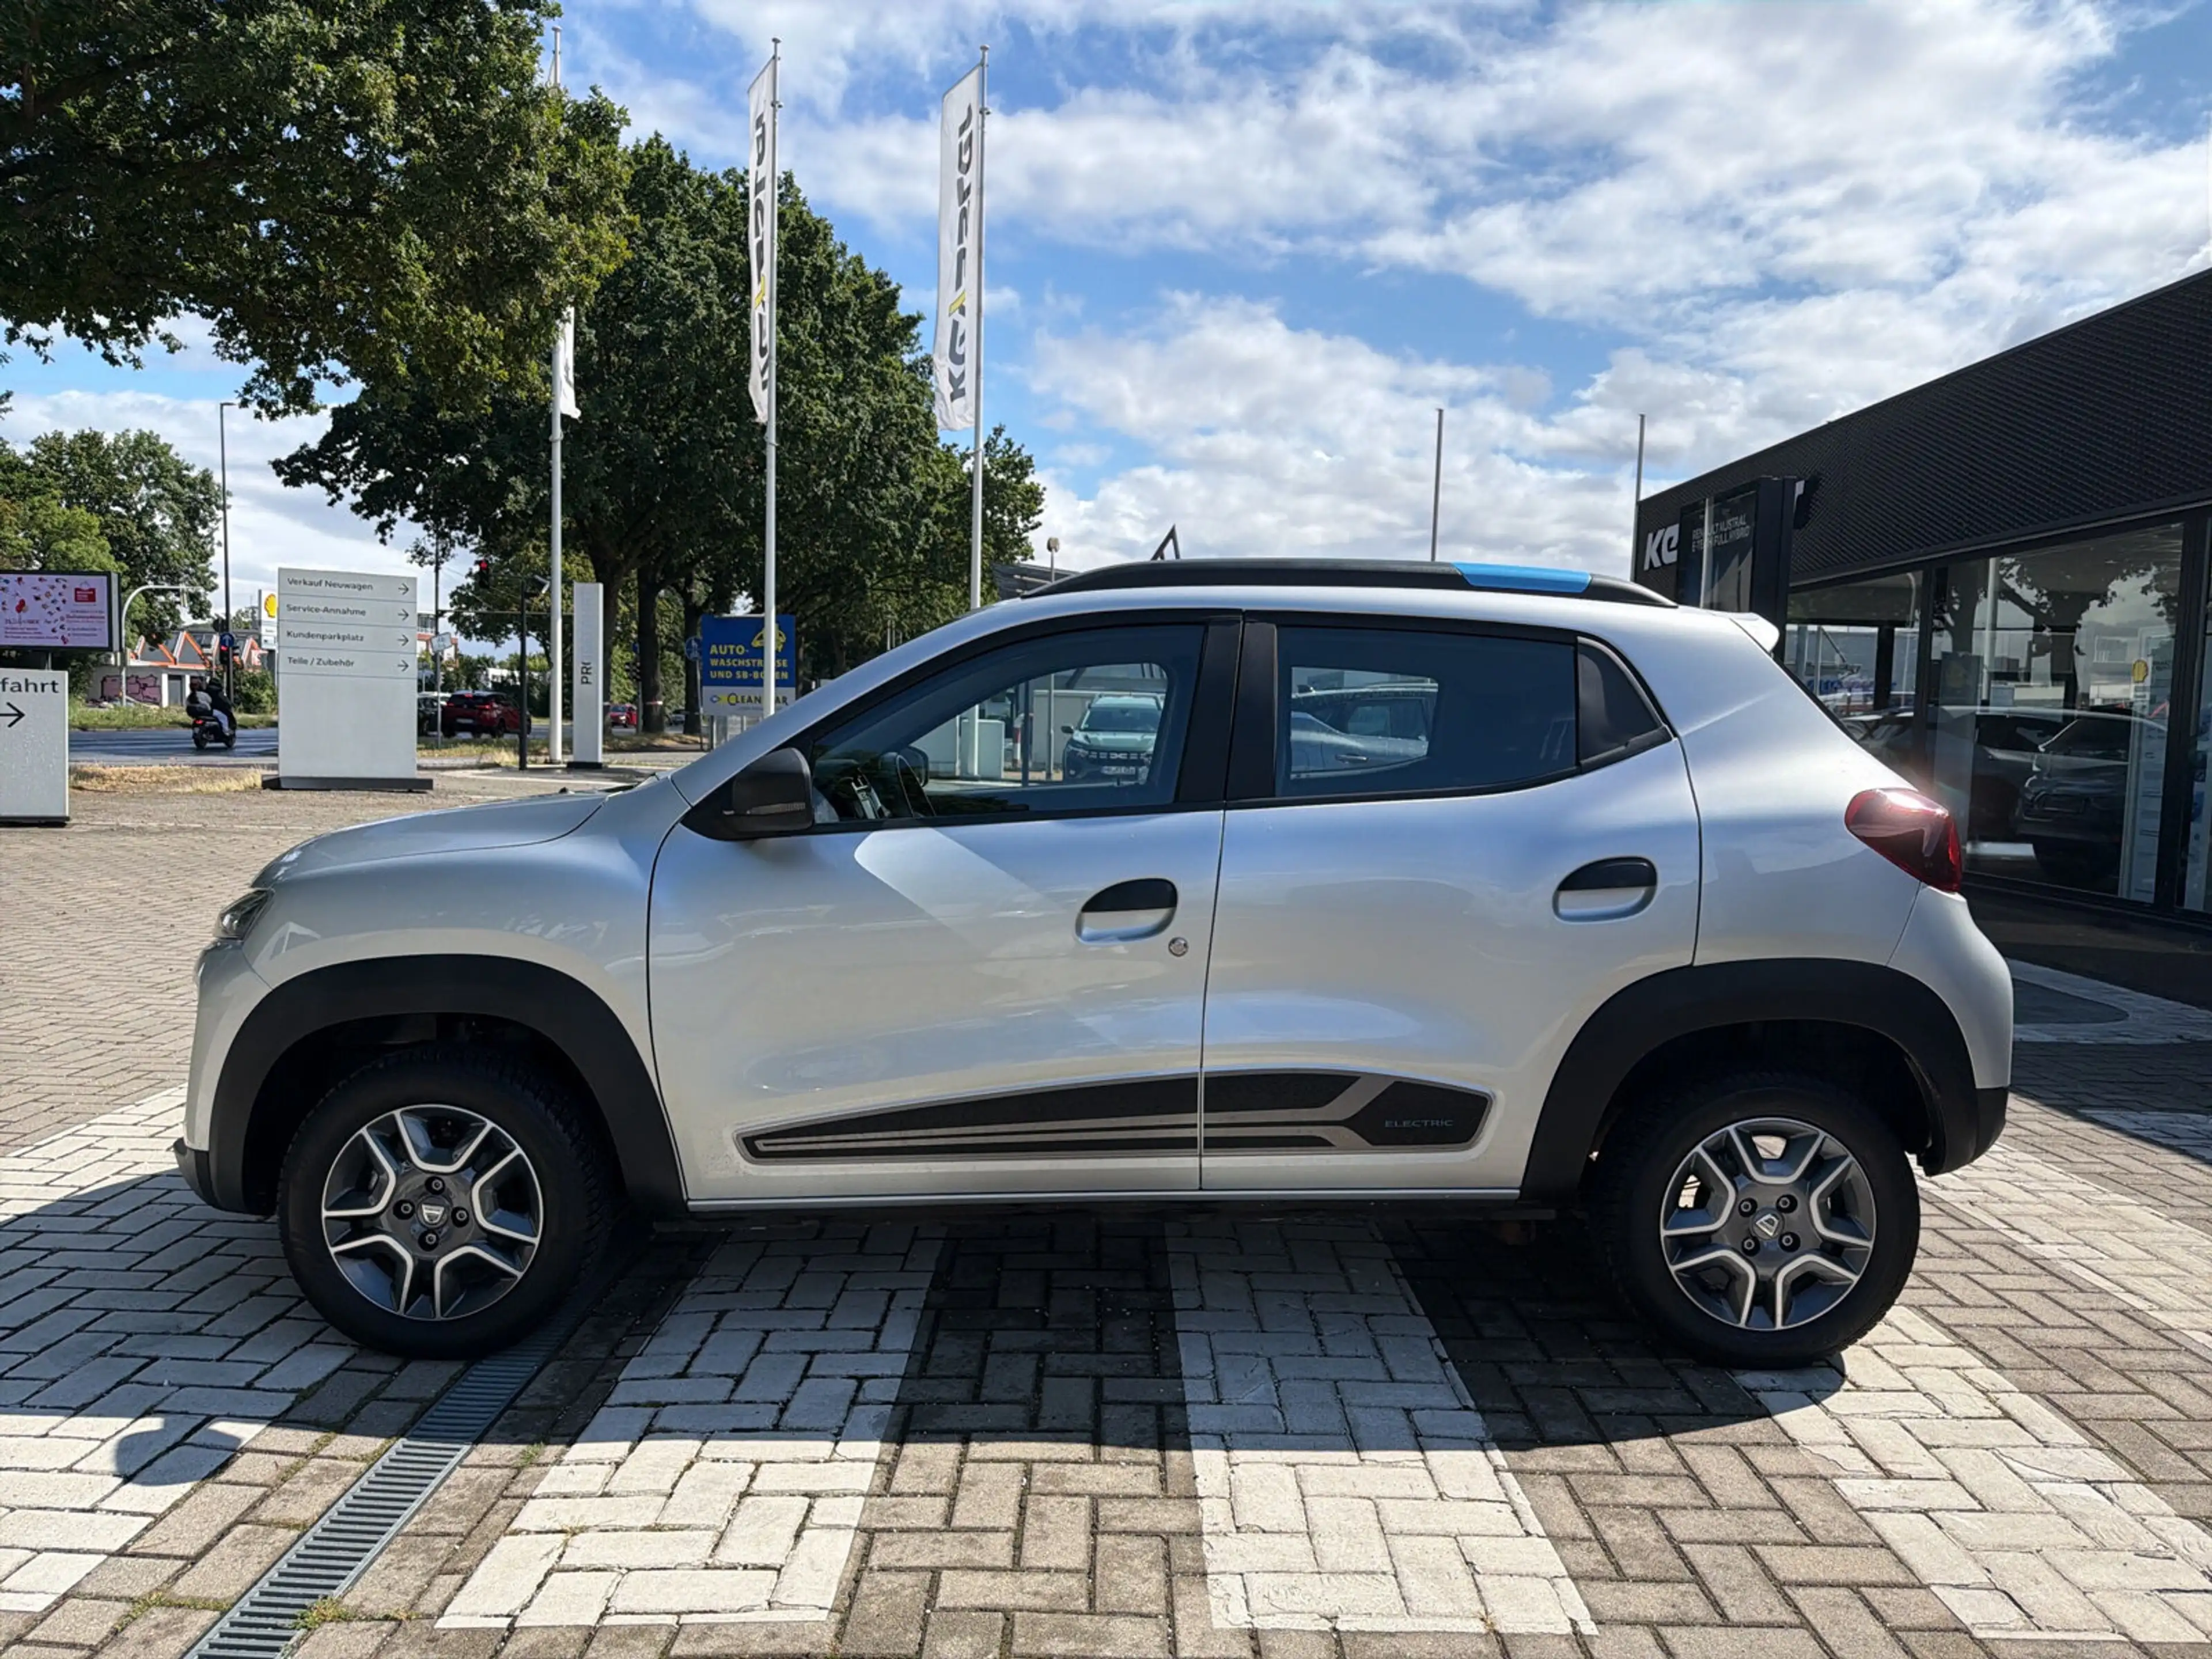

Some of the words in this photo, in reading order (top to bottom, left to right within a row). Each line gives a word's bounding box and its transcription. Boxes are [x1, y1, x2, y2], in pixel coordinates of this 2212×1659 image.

[287, 578, 323, 588] Verkauf
[325, 581, 373, 592] Neuwagen
[287, 604, 366, 616] Service-Annahme
[287, 631, 364, 642] Kundenparkplatz
[710, 644, 749, 655] AUTO-
[288, 657, 308, 665] Teile
[317, 658, 354, 666] Zubehör
[710, 658, 788, 667] WASCHSTRSE
[710, 671, 733, 679] UND
[735, 671, 789, 679] SB-BOEN
[727, 692, 789, 706] CLEANAR
[1385, 1119, 1454, 1127] ELECTRIC
